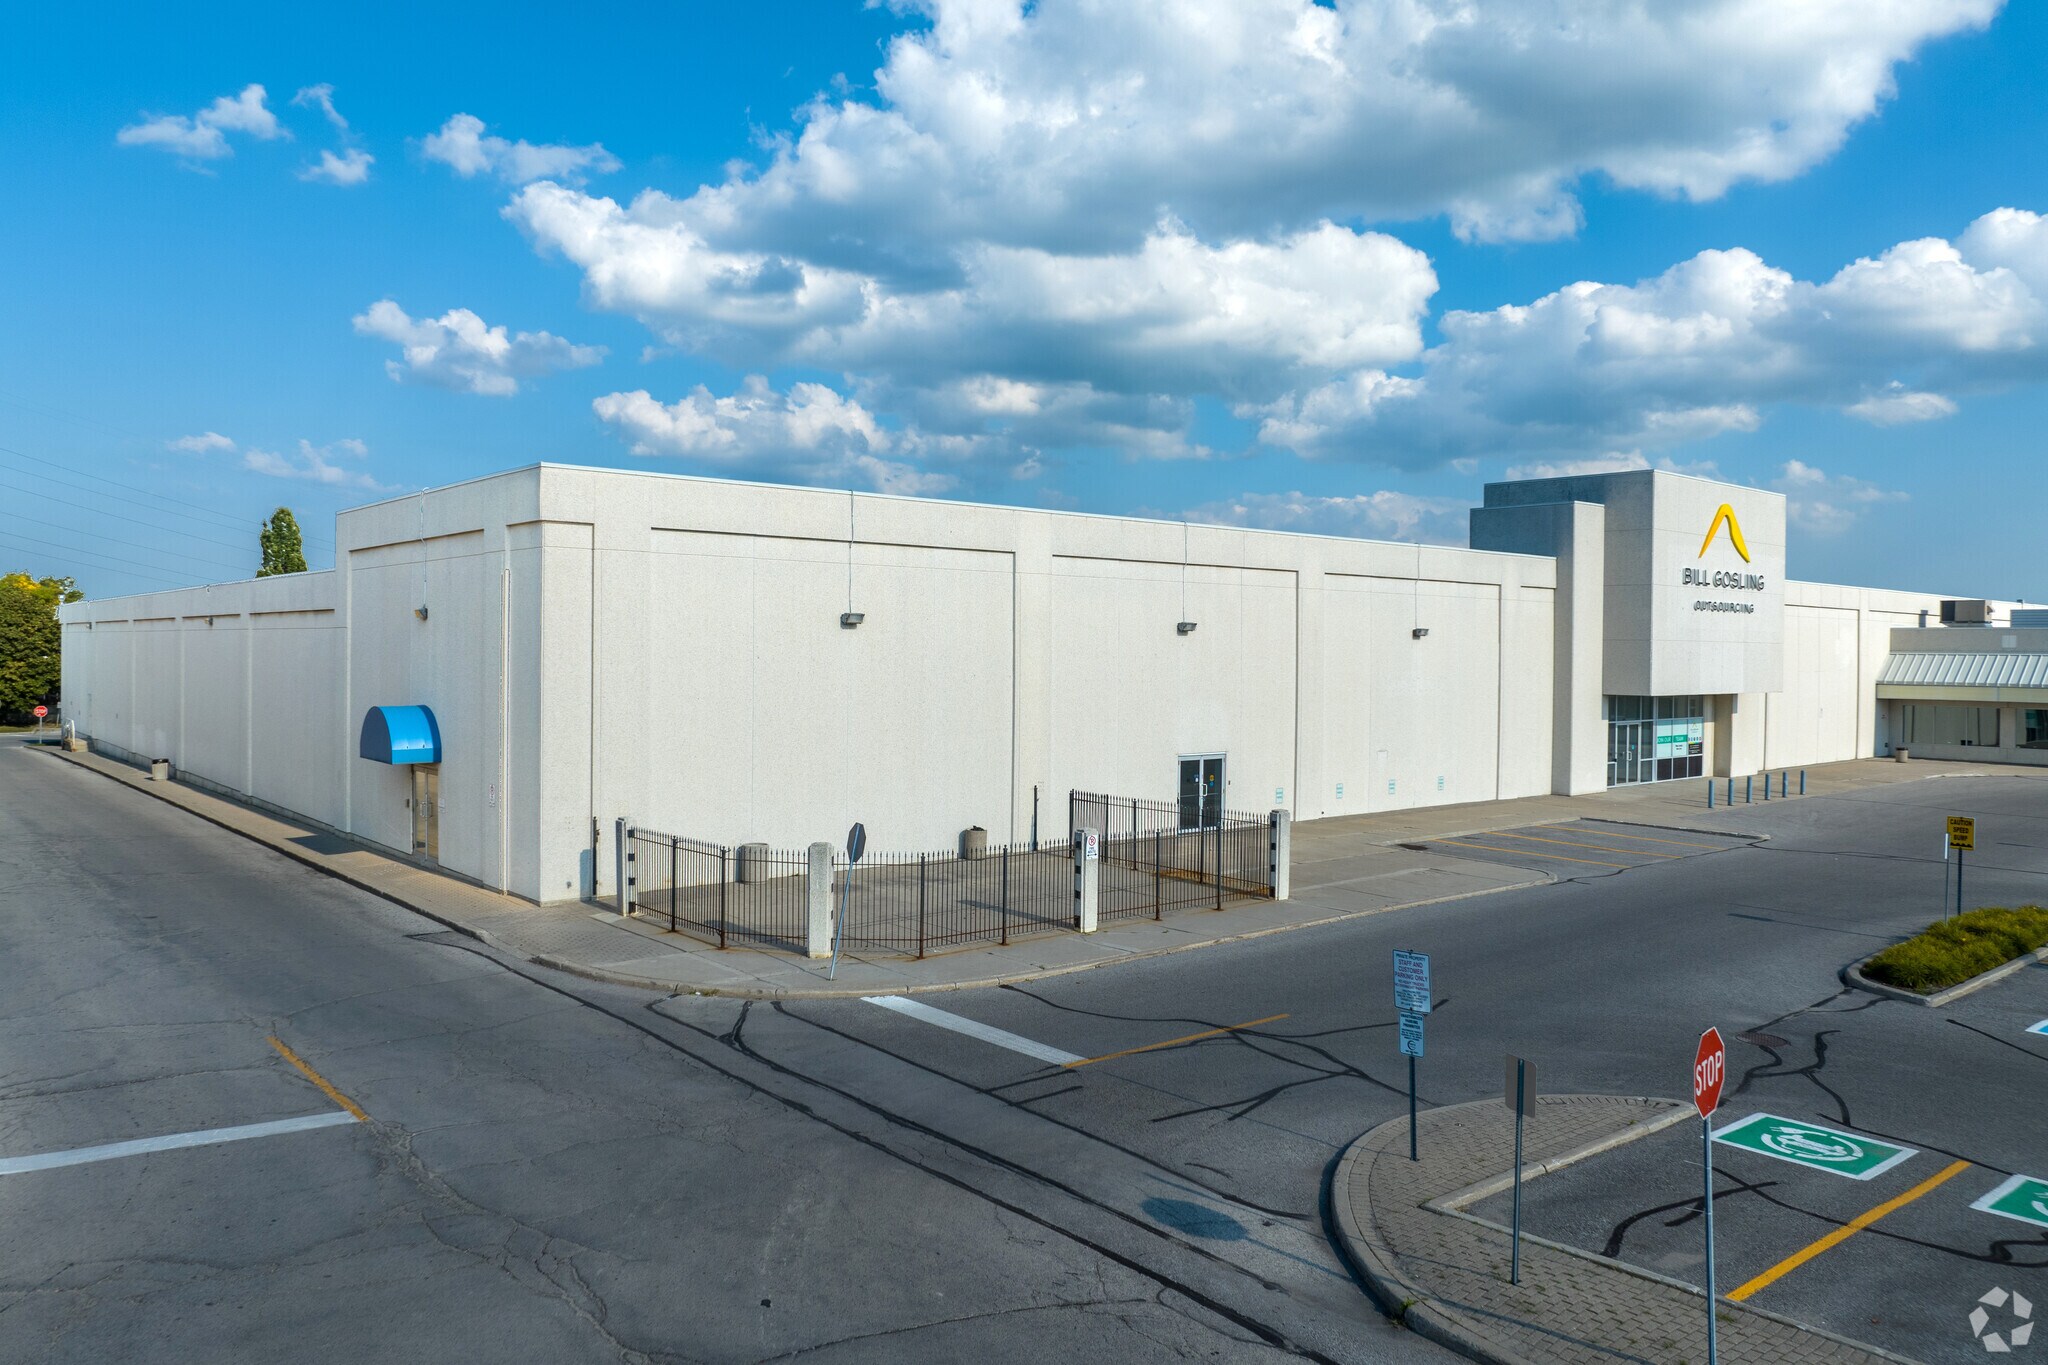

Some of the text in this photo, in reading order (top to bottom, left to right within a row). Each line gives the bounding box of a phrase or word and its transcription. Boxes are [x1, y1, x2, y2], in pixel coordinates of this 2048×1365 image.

[1682, 567, 1764, 591] BILL GOSLING
[1693, 600, 1754, 614] OUTSOURCING
[1950, 818, 1973, 826] CAUTION
[1394, 971, 1414, 980] PARKING
[1398, 966, 1424, 975] CUSTOMER
[1695, 1050, 1722, 1096] STOP
